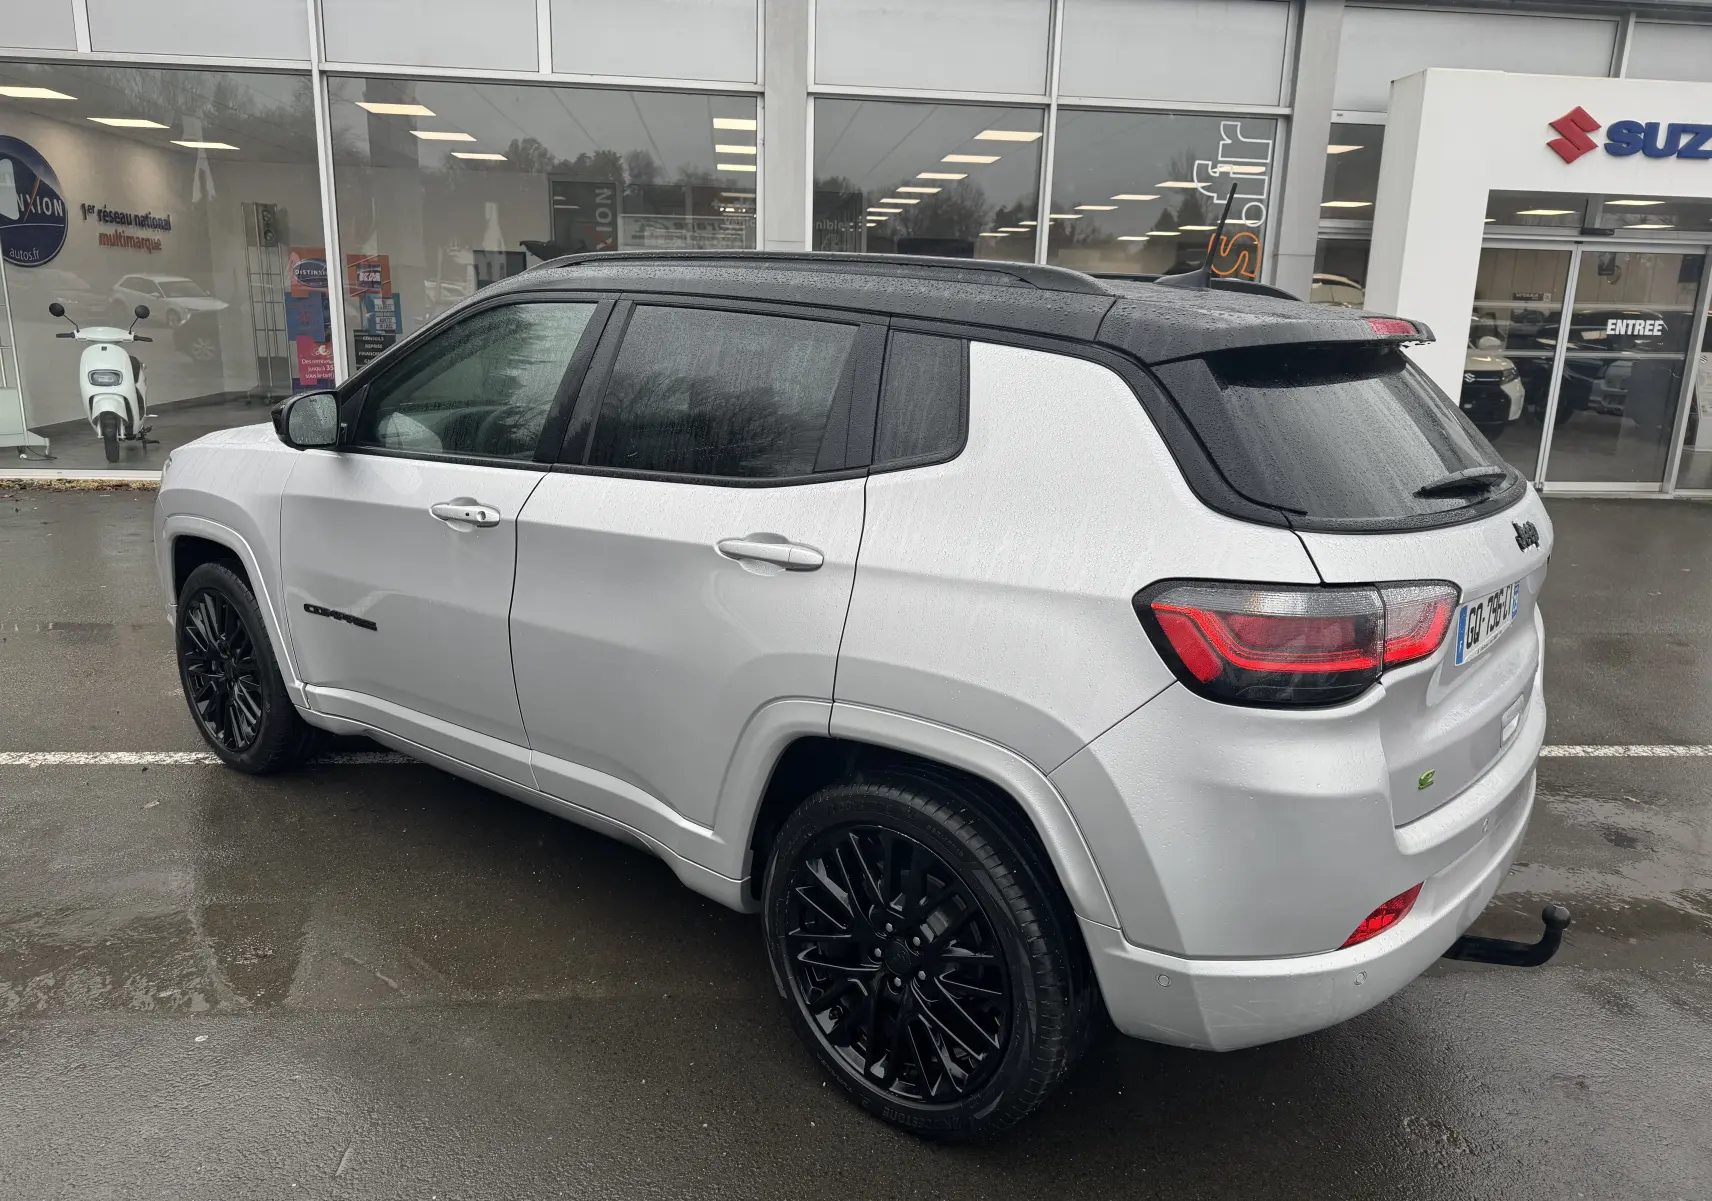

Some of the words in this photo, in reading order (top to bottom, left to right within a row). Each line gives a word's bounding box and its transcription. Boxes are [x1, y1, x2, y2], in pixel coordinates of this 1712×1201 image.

[97, 204, 132, 226] réseau
[134, 211, 172, 231] national
[98, 229, 162, 253] multimarque
[9, 247, 40, 261] autos.fr
[1606, 319, 1664, 336] ENTREE
